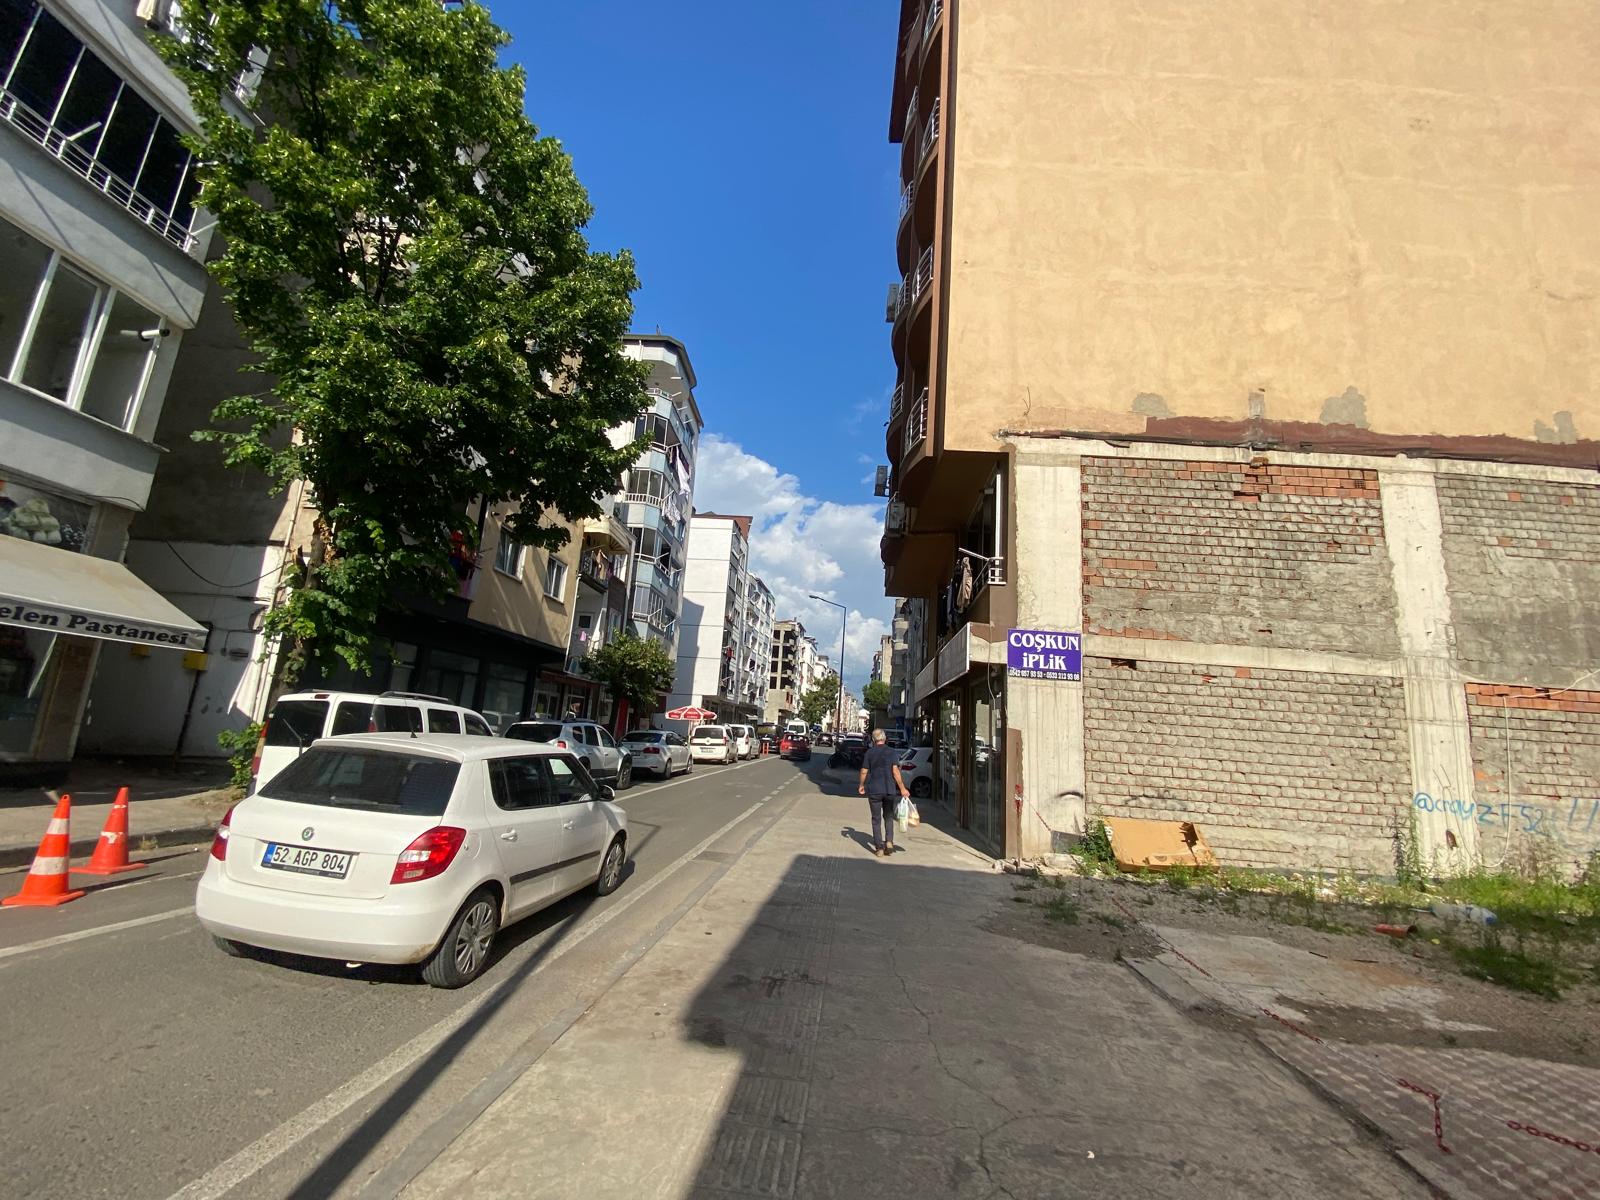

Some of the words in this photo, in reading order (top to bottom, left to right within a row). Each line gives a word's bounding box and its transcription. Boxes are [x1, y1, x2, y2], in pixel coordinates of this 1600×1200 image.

[66, 614, 188, 645] Pastanesi
[1009, 632, 1080, 652] COŞKUN
[273, 846, 289, 863] 52
[293, 850, 318, 866] AGP
[321, 854, 345, 871] 804
